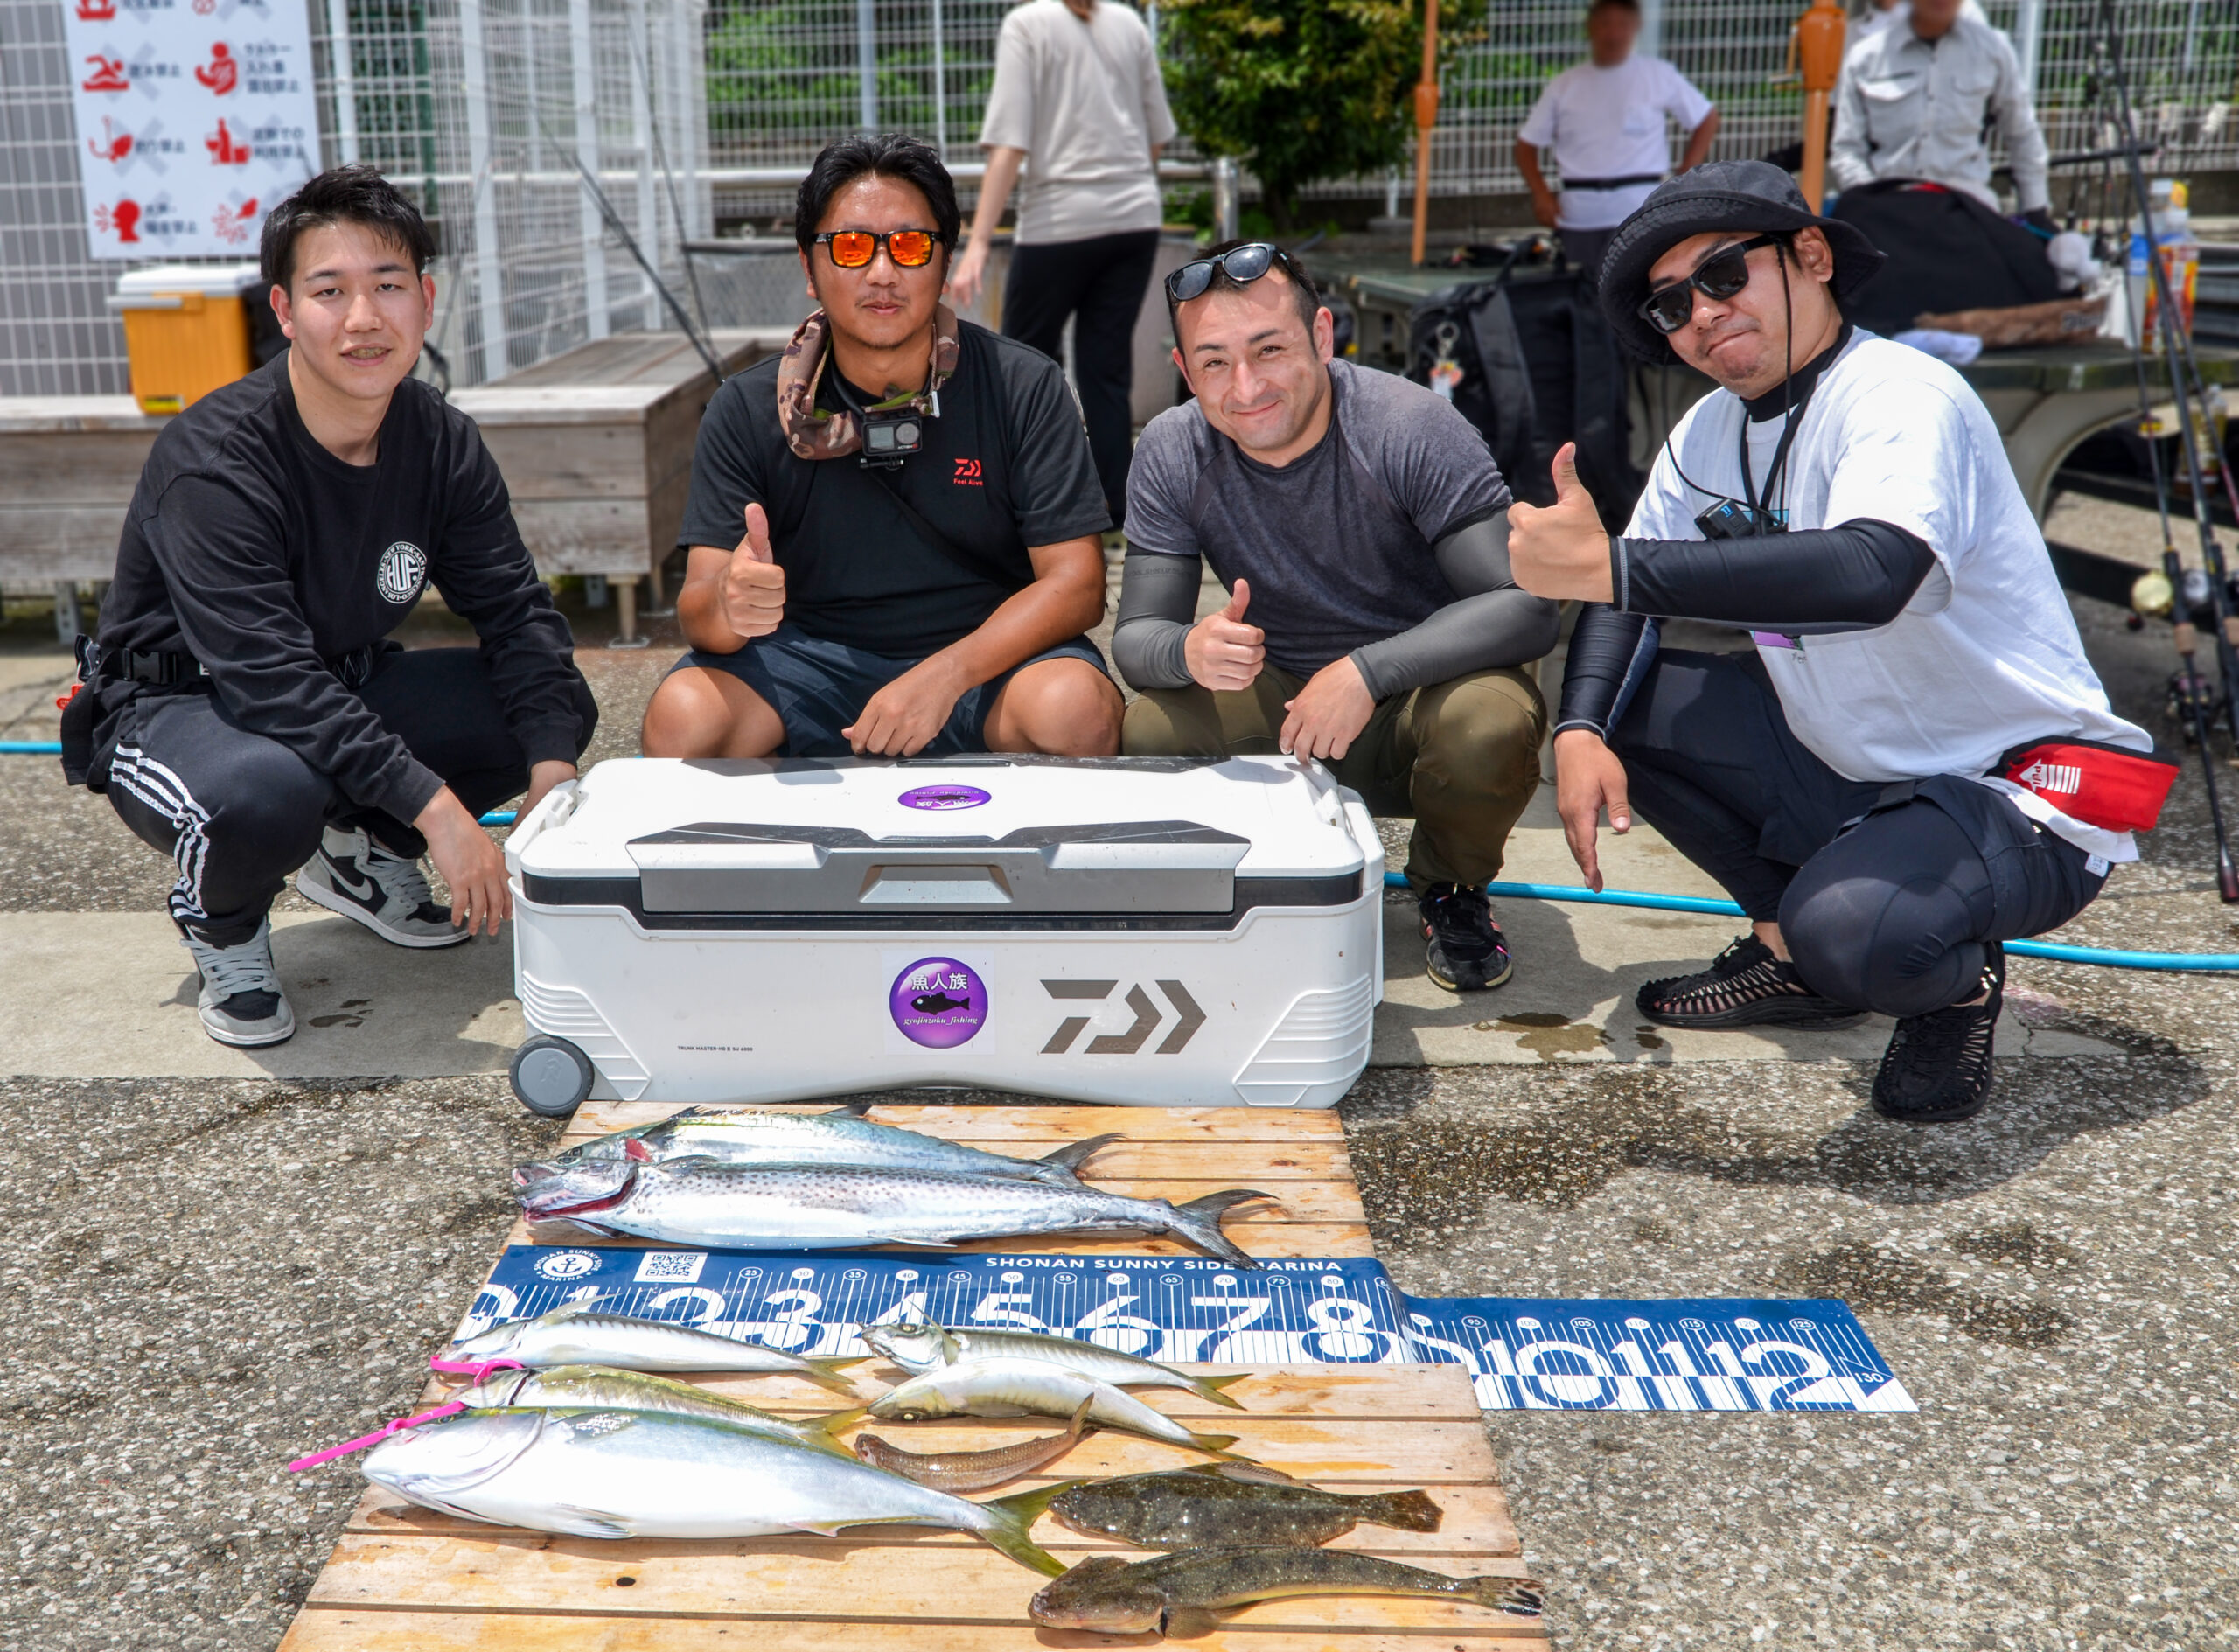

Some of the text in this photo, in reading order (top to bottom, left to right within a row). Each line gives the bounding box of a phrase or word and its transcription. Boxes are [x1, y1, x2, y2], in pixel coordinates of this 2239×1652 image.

[395, 544, 415, 554] YORK
[910, 972, 968, 991] 魚人族
[903, 1016, 978, 1026] gyojinzoku_fishing
[534, 1251, 565, 1271] SHONAN
[986, 1258, 1085, 1269] SHONAN
[1094, 1259, 1175, 1270] SUNNY
[1184, 1260, 1236, 1270] SIDE
[745, 1289, 826, 1355] 3
[1074, 1295, 1165, 1361] 6
[1191, 1296, 1271, 1363] 7
[1301, 1297, 1392, 1363] 8
[1413, 1316, 1426, 1325] 90
[1682, 1320, 1702, 1328] 115
[1738, 1320, 1756, 1328] 120
[1479, 1340, 1620, 1411] 10
[1610, 1341, 1714, 1411] 11
[1704, 1341, 1857, 1411] 12
[1854, 1372, 1884, 1383] 130
